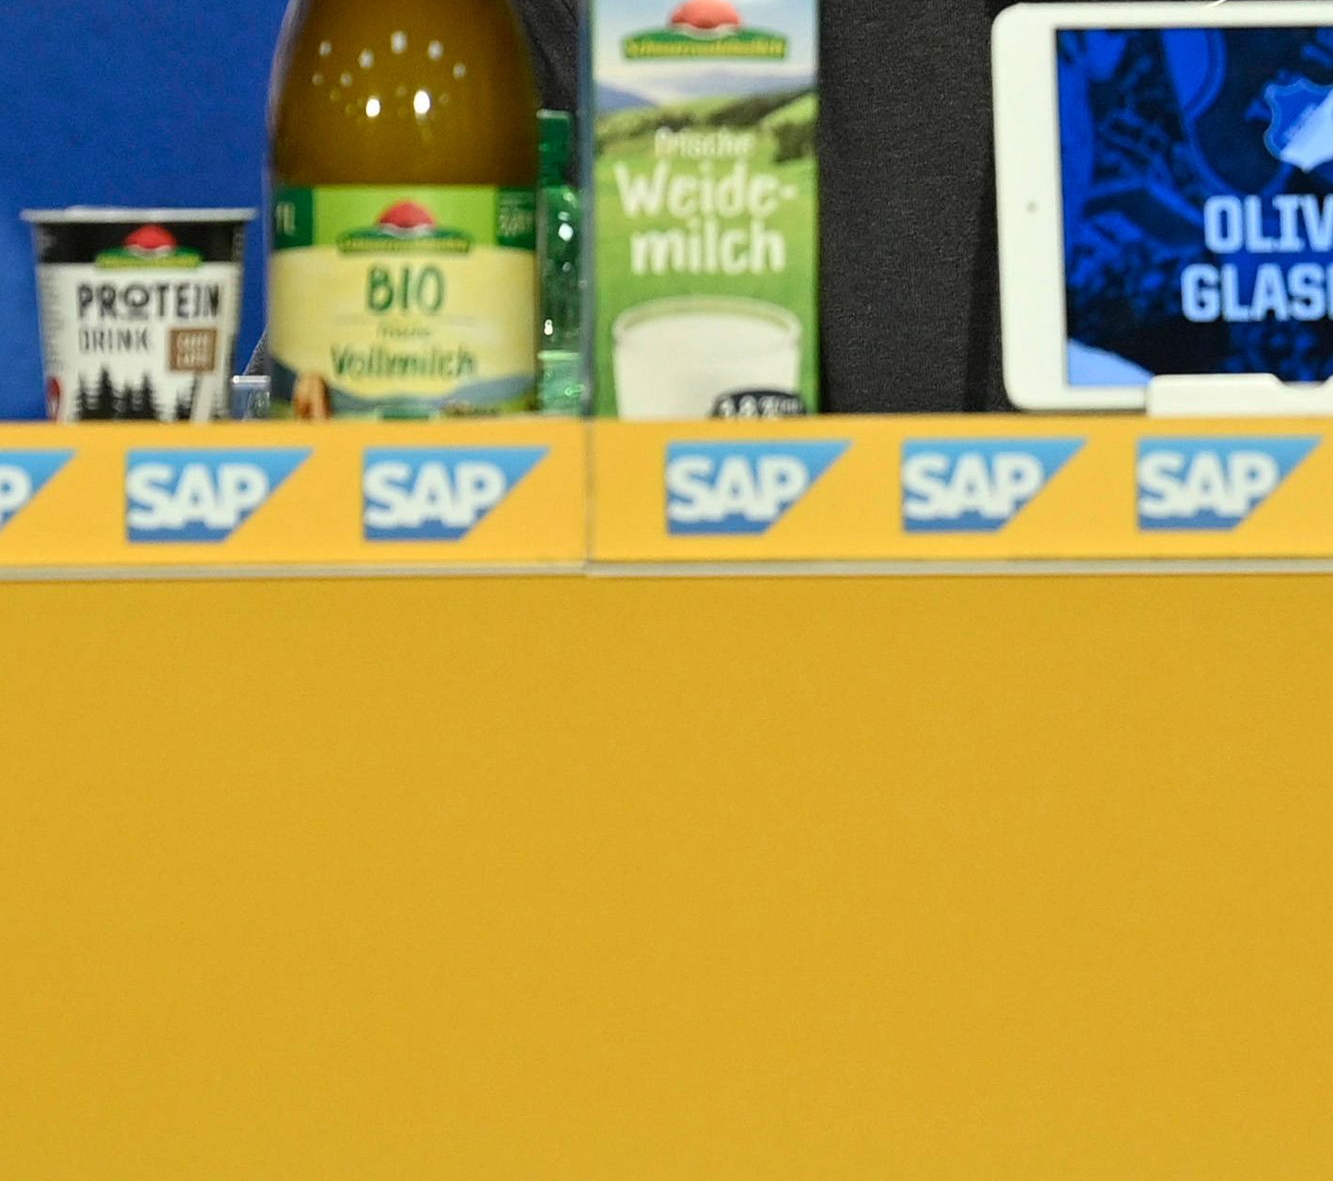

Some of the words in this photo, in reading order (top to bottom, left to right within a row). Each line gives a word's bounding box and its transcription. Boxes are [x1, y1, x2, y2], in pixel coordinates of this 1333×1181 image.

[614, 160, 798, 219] Weide-
[630, 217, 787, 275] milch
[78, 283, 219, 319] PROTEIN
[367, 264, 443, 313] BIO
[78, 327, 149, 354] DRINK
[332, 344, 478, 378] Vollmilch
[127, 463, 269, 528] SAP
[364, 461, 505, 527] SAP
[667, 456, 808, 522] SAP
[903, 453, 1044, 520] SAP
[1138, 451, 1279, 518] SAP
